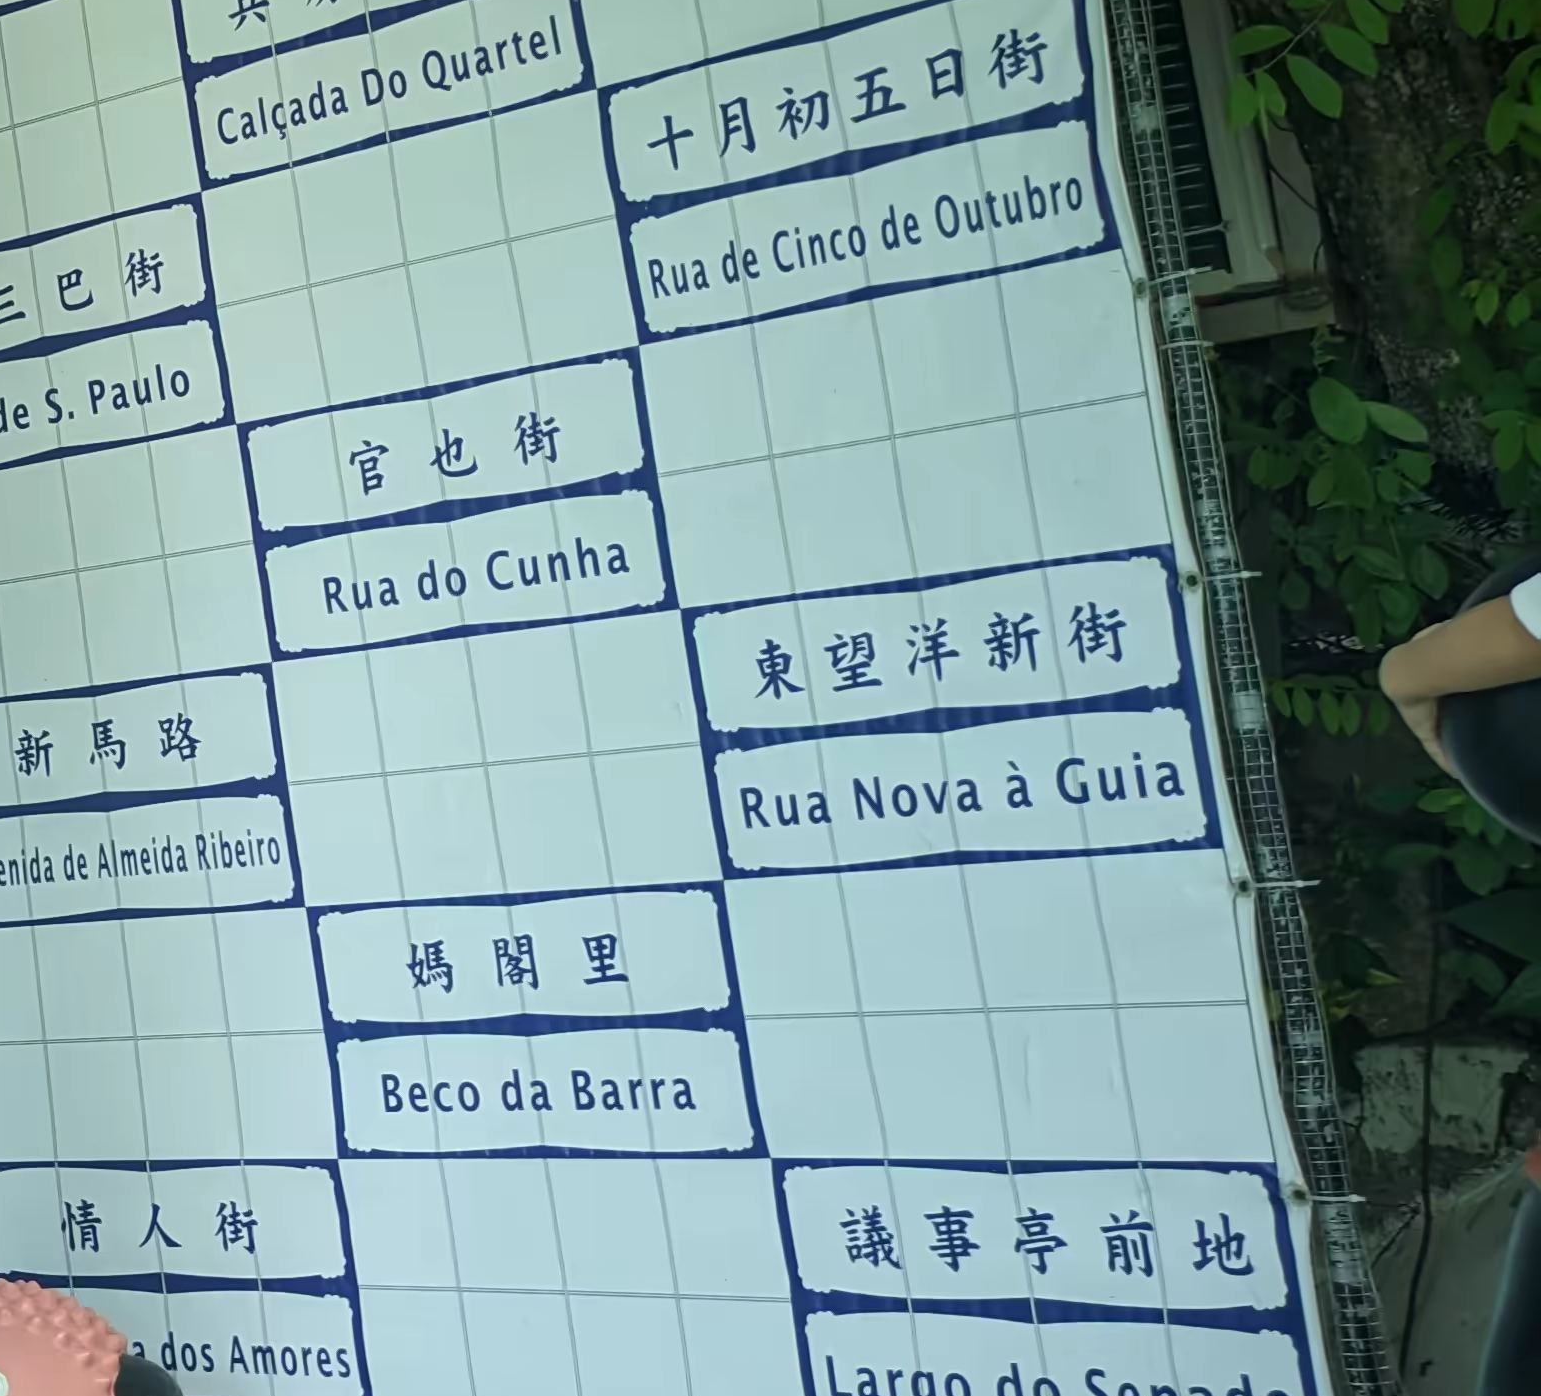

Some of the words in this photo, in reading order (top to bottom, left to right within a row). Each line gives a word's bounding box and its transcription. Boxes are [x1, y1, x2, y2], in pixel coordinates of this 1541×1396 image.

[217, 80, 349, 144] Calçada
[361, 68, 407, 107] Do
[422, 14, 562, 91] Quartel
[646, 28, 1048, 171] 十月初五日街
[648, 258, 710, 299] Rua
[722, 240, 760, 284] de
[772, 224, 867, 273] Cinco
[881, 204, 921, 251] de
[935, 174, 1084, 241] Outubro
[45, 388, 75, 424] S.
[88, 364, 191, 414] Paulo
[348, 411, 562, 496] 官也街
[323, 576, 400, 614] Rua
[417, 559, 467, 601] do
[486, 537, 630, 591] Cunha
[753, 601, 1128, 700] 東望洋新街
[14, 712, 202, 777] 新馬路
[739, 786, 832, 829] Rua
[852, 776, 982, 820] Nova
[1005, 761, 1034, 807] à
[1056, 751, 1186, 805] Guia
[63, 843, 88, 881] de
[98, 835, 188, 878] Almeida
[195, 828, 281, 871] Ribeiro
[405, 933, 630, 994] 媽閣里
[381, 1073, 481, 1114] Beco
[501, 1069, 553, 1112] da
[571, 1069, 697, 1112] Barra
[61, 1199, 259, 1254] 情人街
[839, 1204, 1255, 1278] 議事亭前地
[160, 1331, 215, 1373] dos
[230, 1335, 352, 1378] Amores
